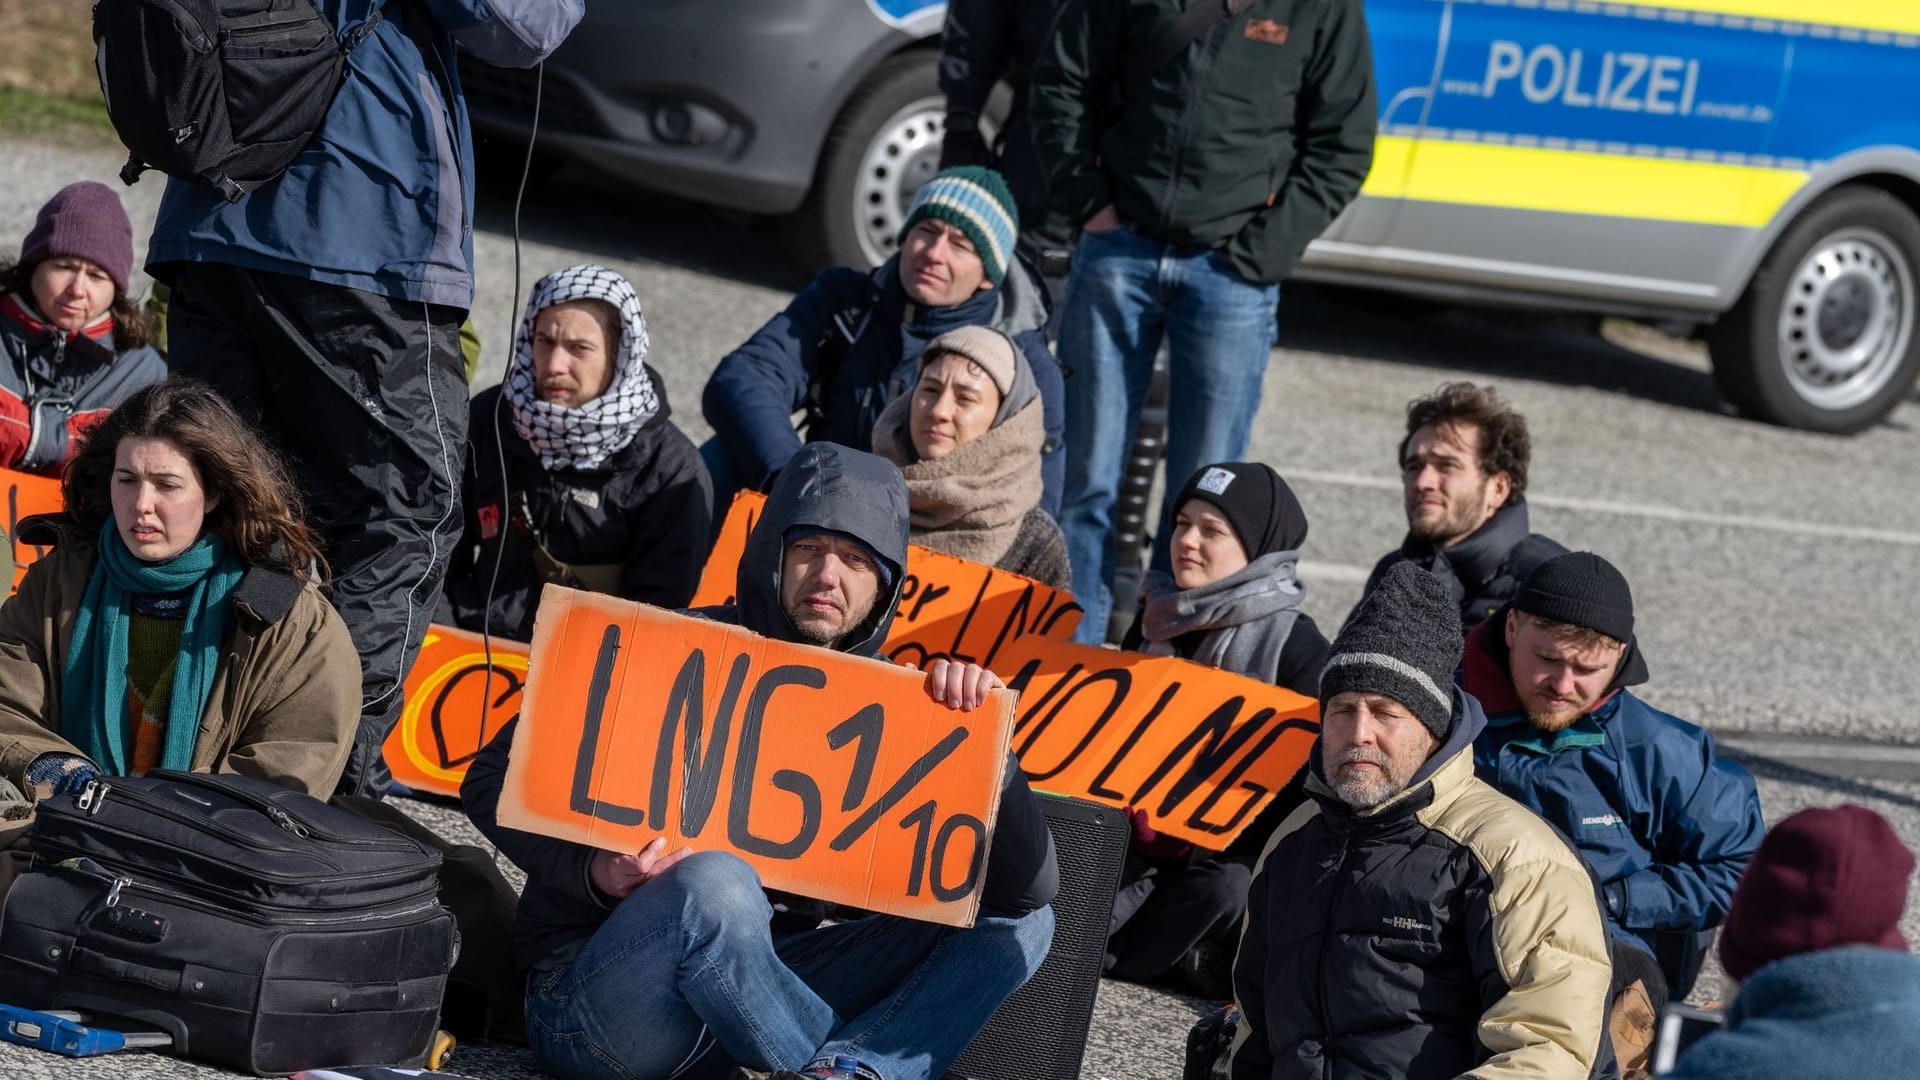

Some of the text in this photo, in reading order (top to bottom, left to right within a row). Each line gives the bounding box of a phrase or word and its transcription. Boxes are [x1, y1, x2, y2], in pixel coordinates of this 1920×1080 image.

[1482, 39, 1699, 116] POLIZEI
[569, 624, 827, 860] LNG
[1087, 681, 1320, 835] LNG
